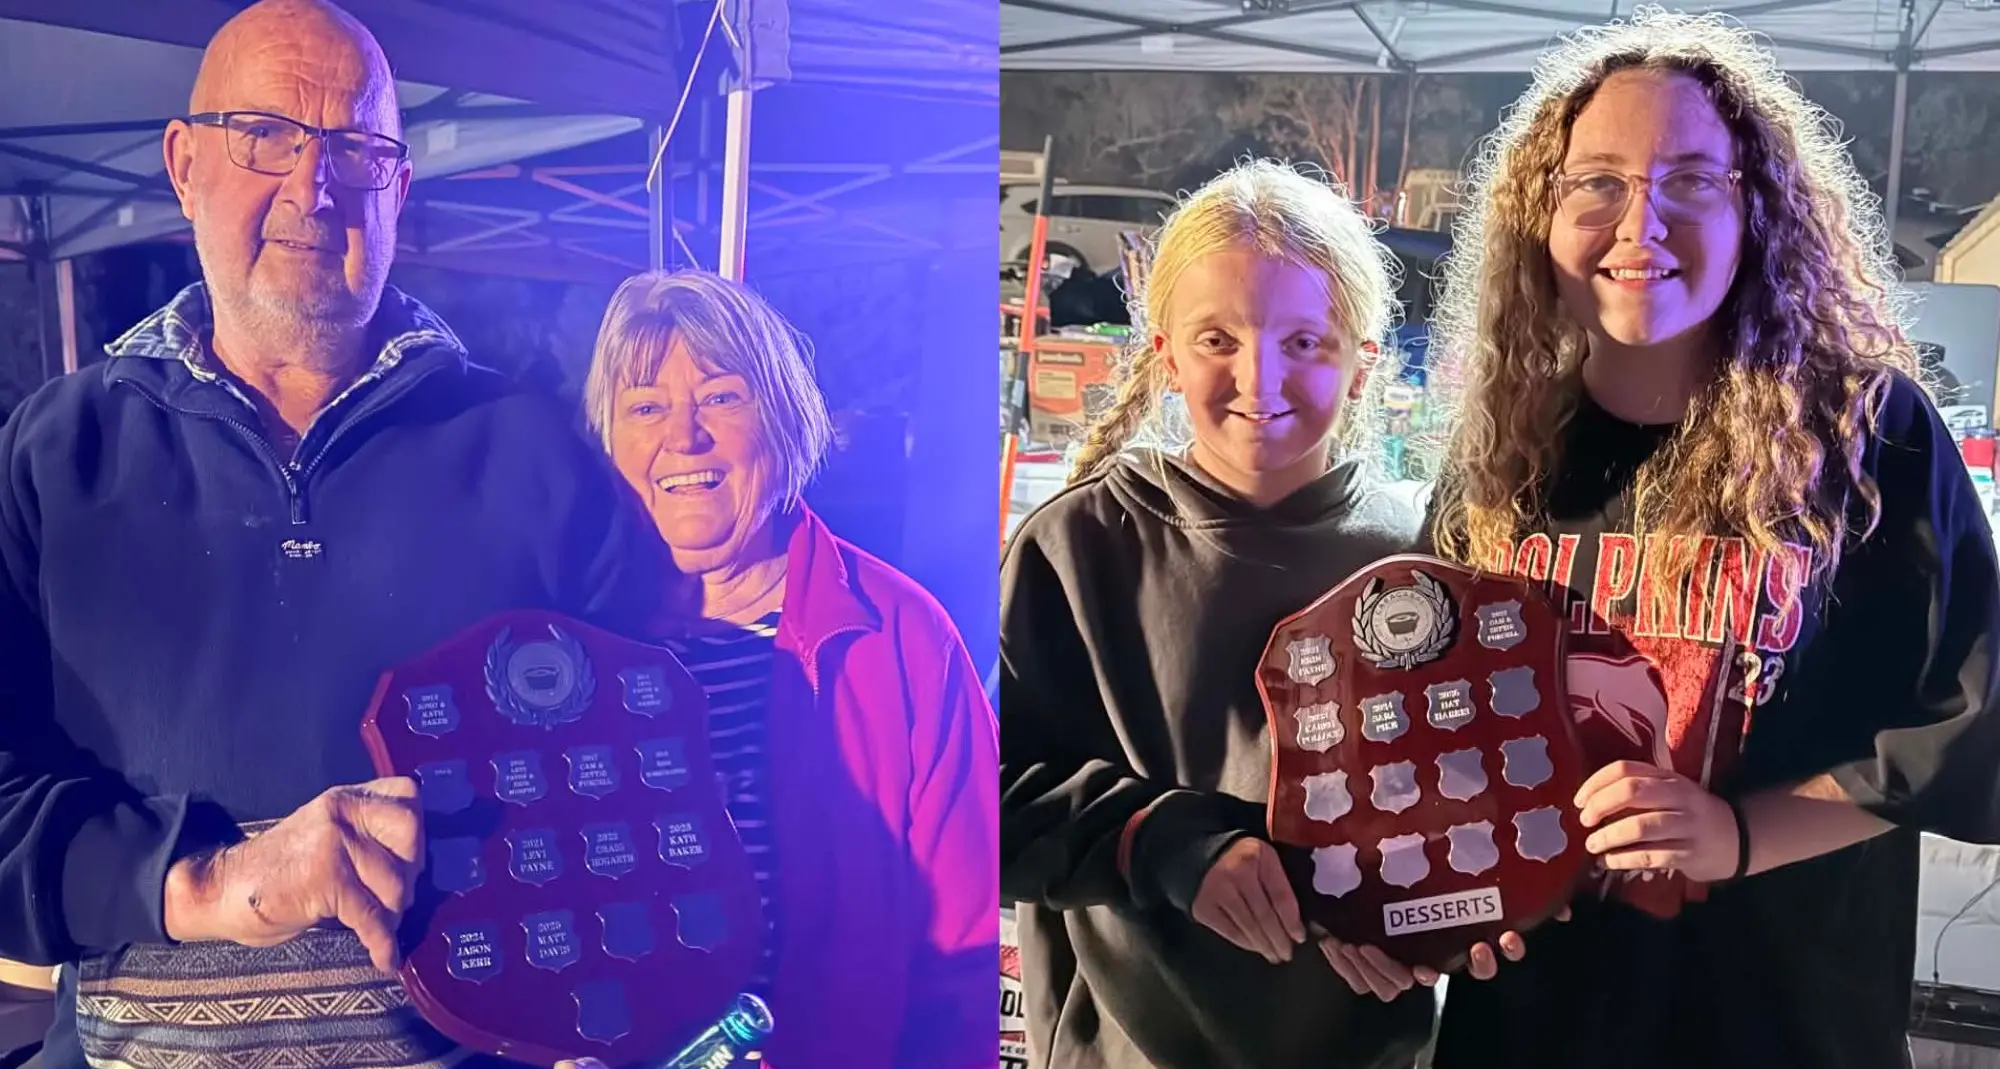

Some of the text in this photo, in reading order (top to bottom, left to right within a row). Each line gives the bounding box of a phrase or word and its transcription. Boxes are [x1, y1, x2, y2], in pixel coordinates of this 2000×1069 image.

[1728, 652, 1785, 706] 23
[669, 833, 697, 845] KATH
[668, 844, 703, 857] BAKER
[519, 860, 555, 873] PAYNE
[1389, 895, 1496, 928] DESSERTS
[459, 931, 485, 943] 2024
[537, 931, 568, 945] MATT
[456, 943, 492, 957] JASON
[538, 944, 572, 959] DAVIS
[461, 956, 492, 970] KERR
